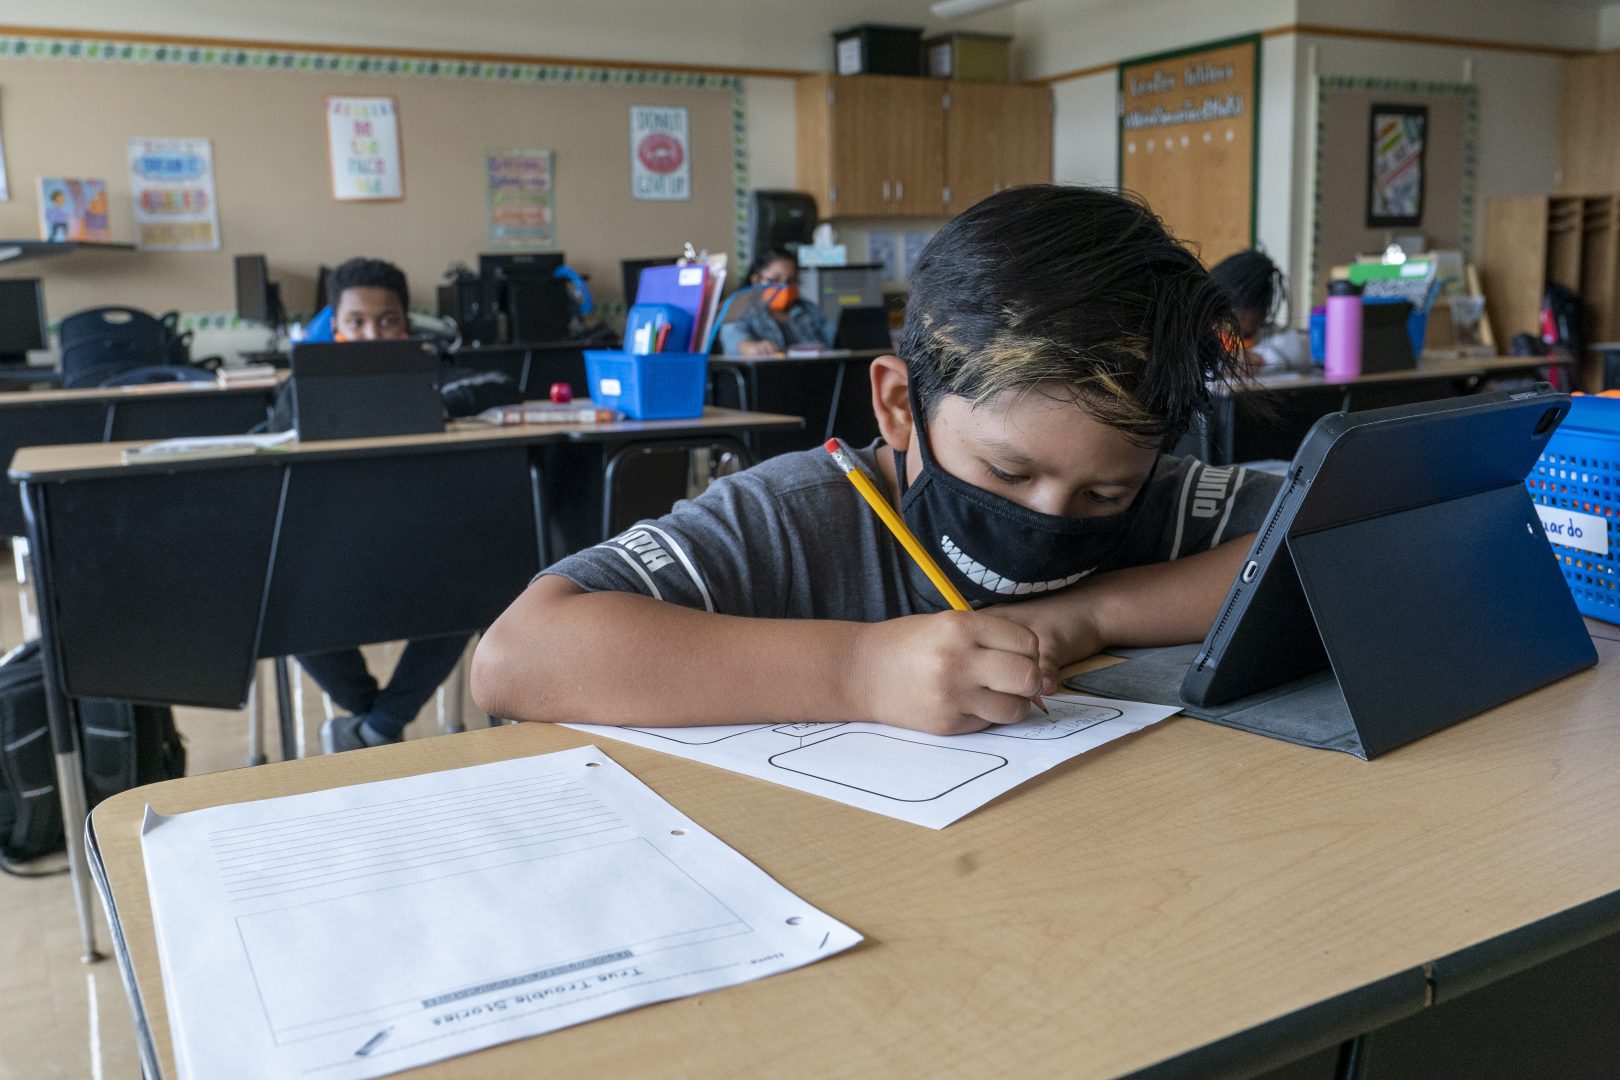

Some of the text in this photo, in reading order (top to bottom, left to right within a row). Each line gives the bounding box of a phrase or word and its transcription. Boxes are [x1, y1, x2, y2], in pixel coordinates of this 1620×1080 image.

[1191, 466, 1234, 518] PUM
[597, 967, 643, 983] True
[515, 980, 591, 1004] Trouble
[433, 1000, 507, 1026] Stories
